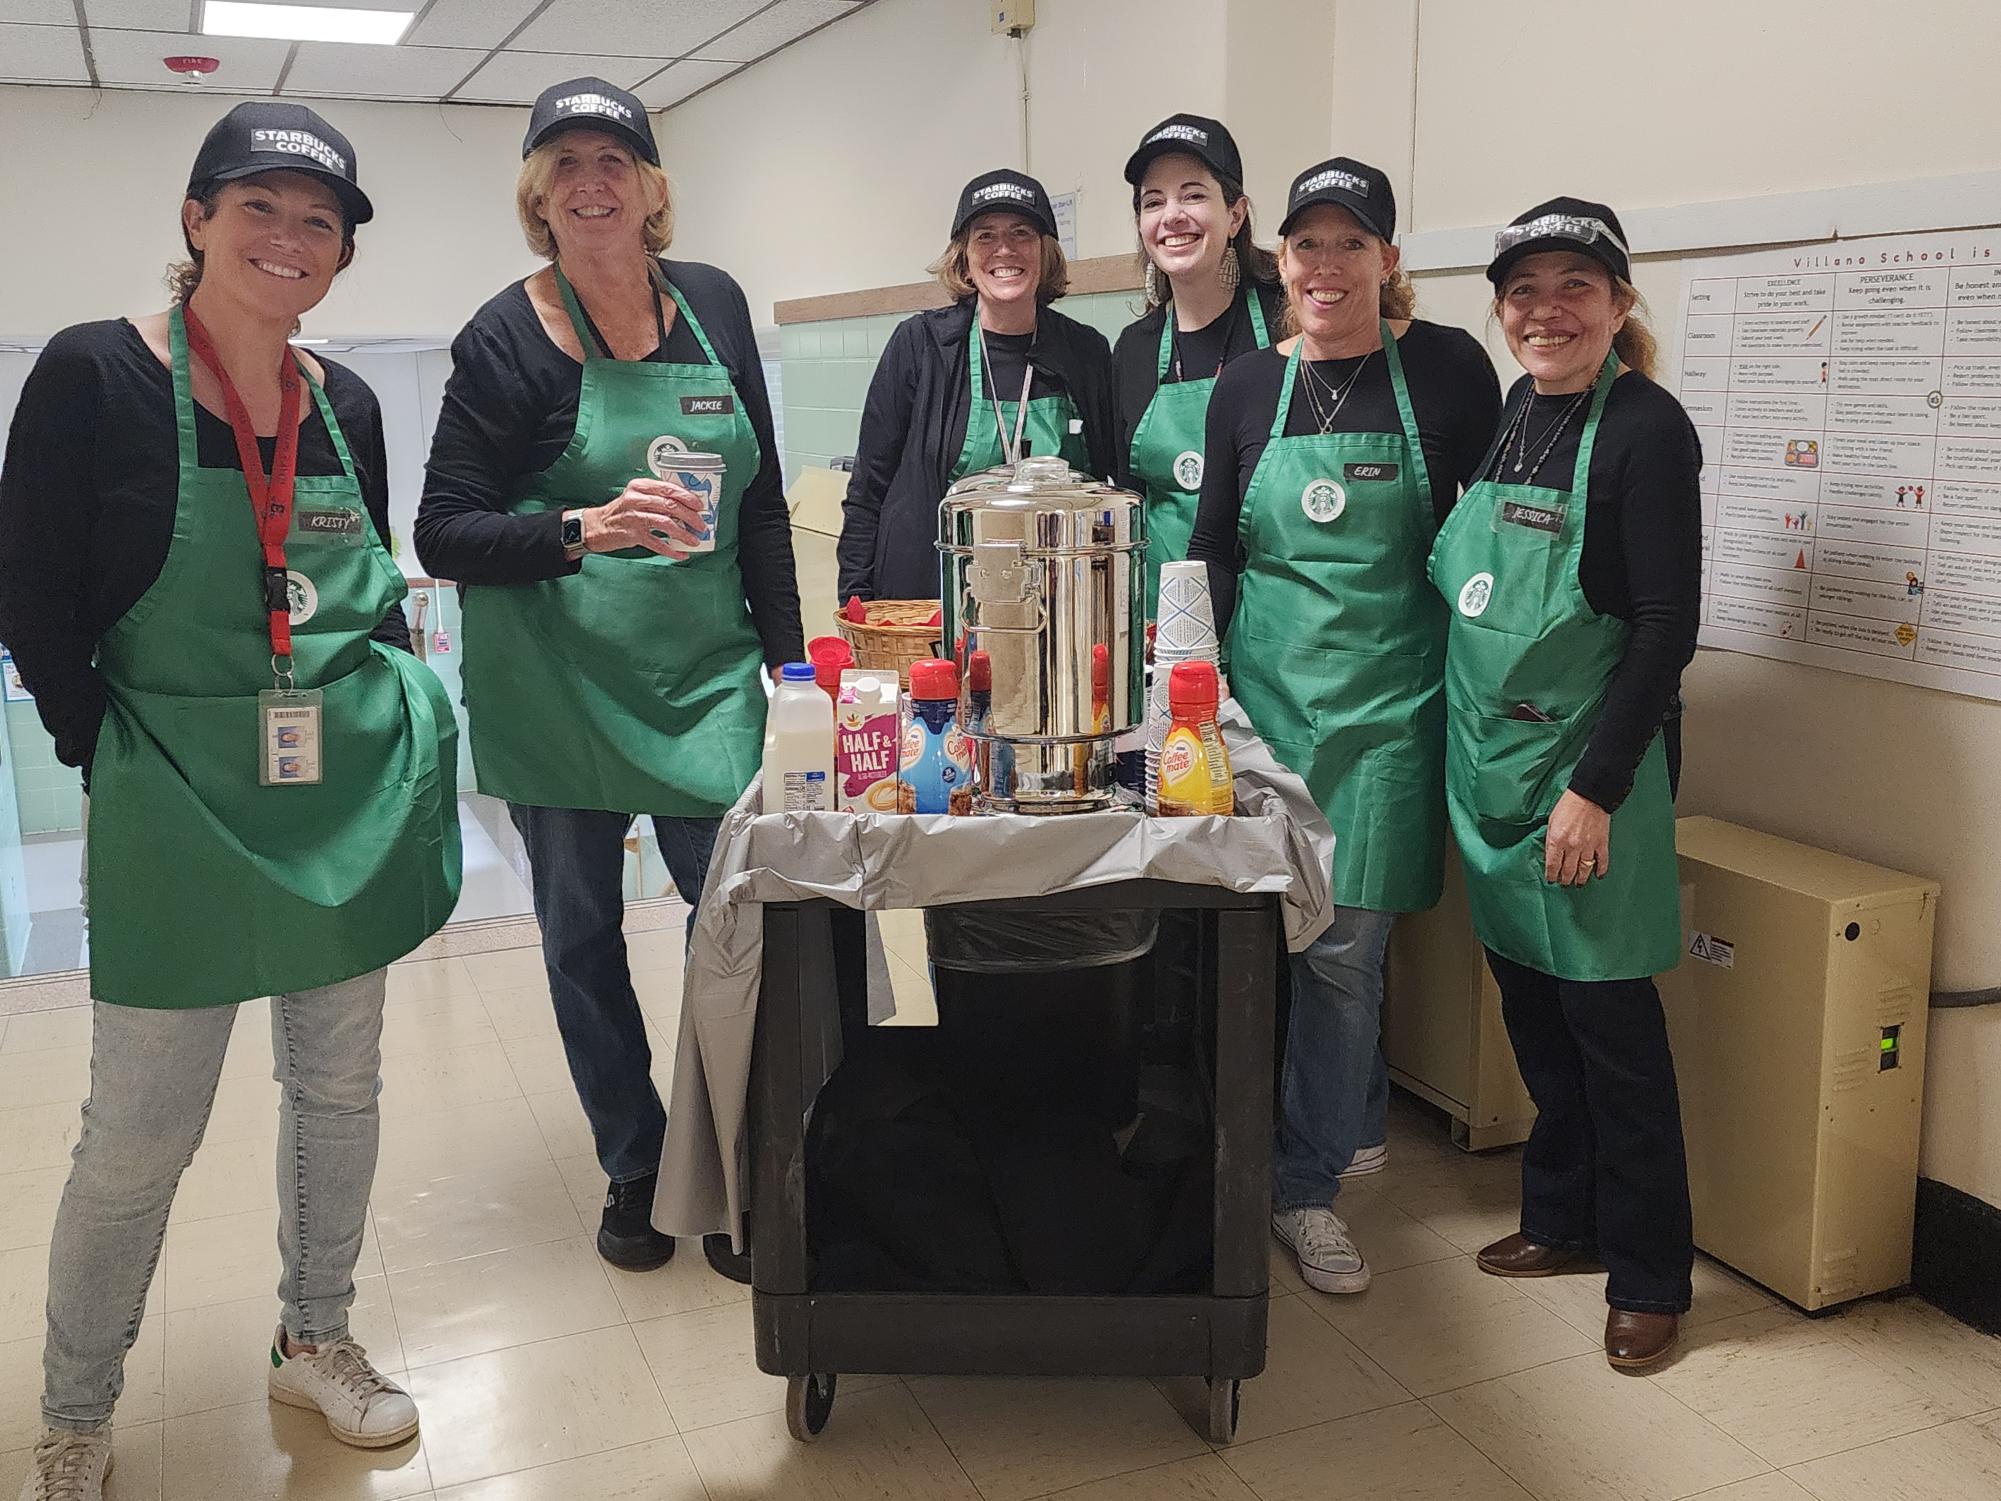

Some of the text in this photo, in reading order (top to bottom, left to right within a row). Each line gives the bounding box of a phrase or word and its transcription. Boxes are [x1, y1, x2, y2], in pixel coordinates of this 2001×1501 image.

[556, 93, 632, 119] STARBUCKS
[571, 103, 620, 120] COFFEE
[254, 130, 346, 170] STARBUCKS
[275, 141, 334, 169] COFFEE
[1298, 169, 1368, 192] STARBUCKS
[1308, 179, 1353, 193] COFFEE
[973, 183, 1033, 199] STARBUCKS
[984, 190, 1022, 201] COFFEE
[1794, 246, 1991, 269] Villano School is
[1767, 279, 1801, 287] EXCELLENCE
[1860, 273, 1914, 284] PERSEVERANCE
[690, 400, 723, 413] JACKIE
[1354, 466, 1381, 477] ERIN
[311, 516, 351, 530] KRISTY
[1512, 507, 1552, 525] JESSICA
[842, 732, 892, 754] HALF &
[850, 751, 890, 773] HALF
[1163, 751, 1189, 765] Coffee
[1166, 760, 1190, 773] mate
